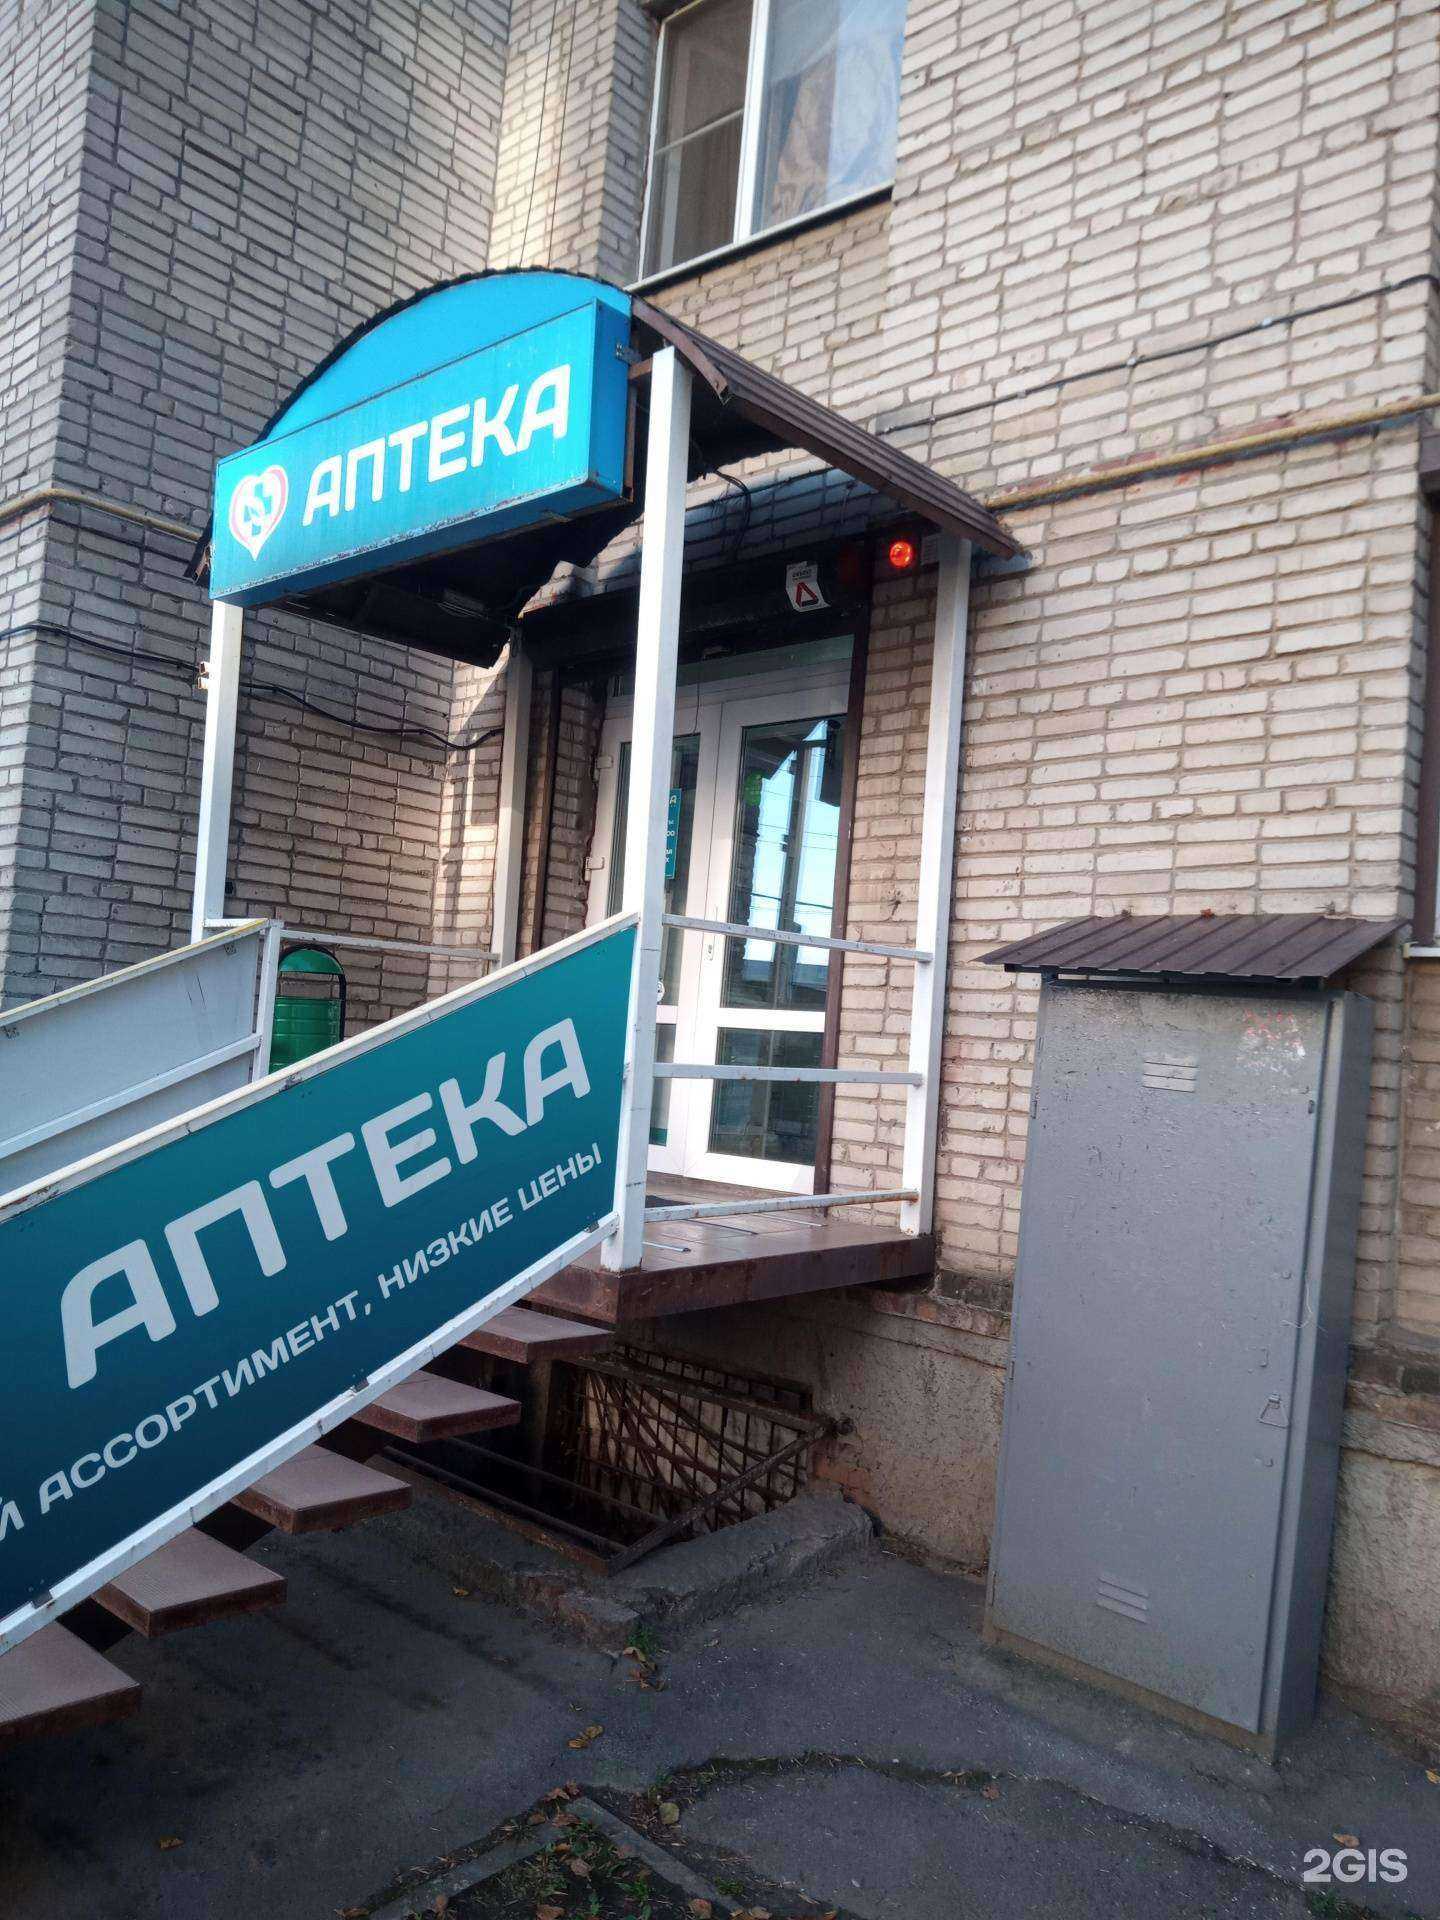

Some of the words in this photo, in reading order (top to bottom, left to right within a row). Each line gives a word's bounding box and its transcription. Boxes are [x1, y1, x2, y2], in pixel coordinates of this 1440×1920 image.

[302, 363, 571, 527] АПТЕКА
[39, 1290, 372, 1514] АССОРТИМЕНТ,
[377, 1197, 514, 1300] НИЗКИЕ
[517, 1142, 603, 1211] ЦЕНЫ
[60, 1018, 591, 1390] АПТЕКА
